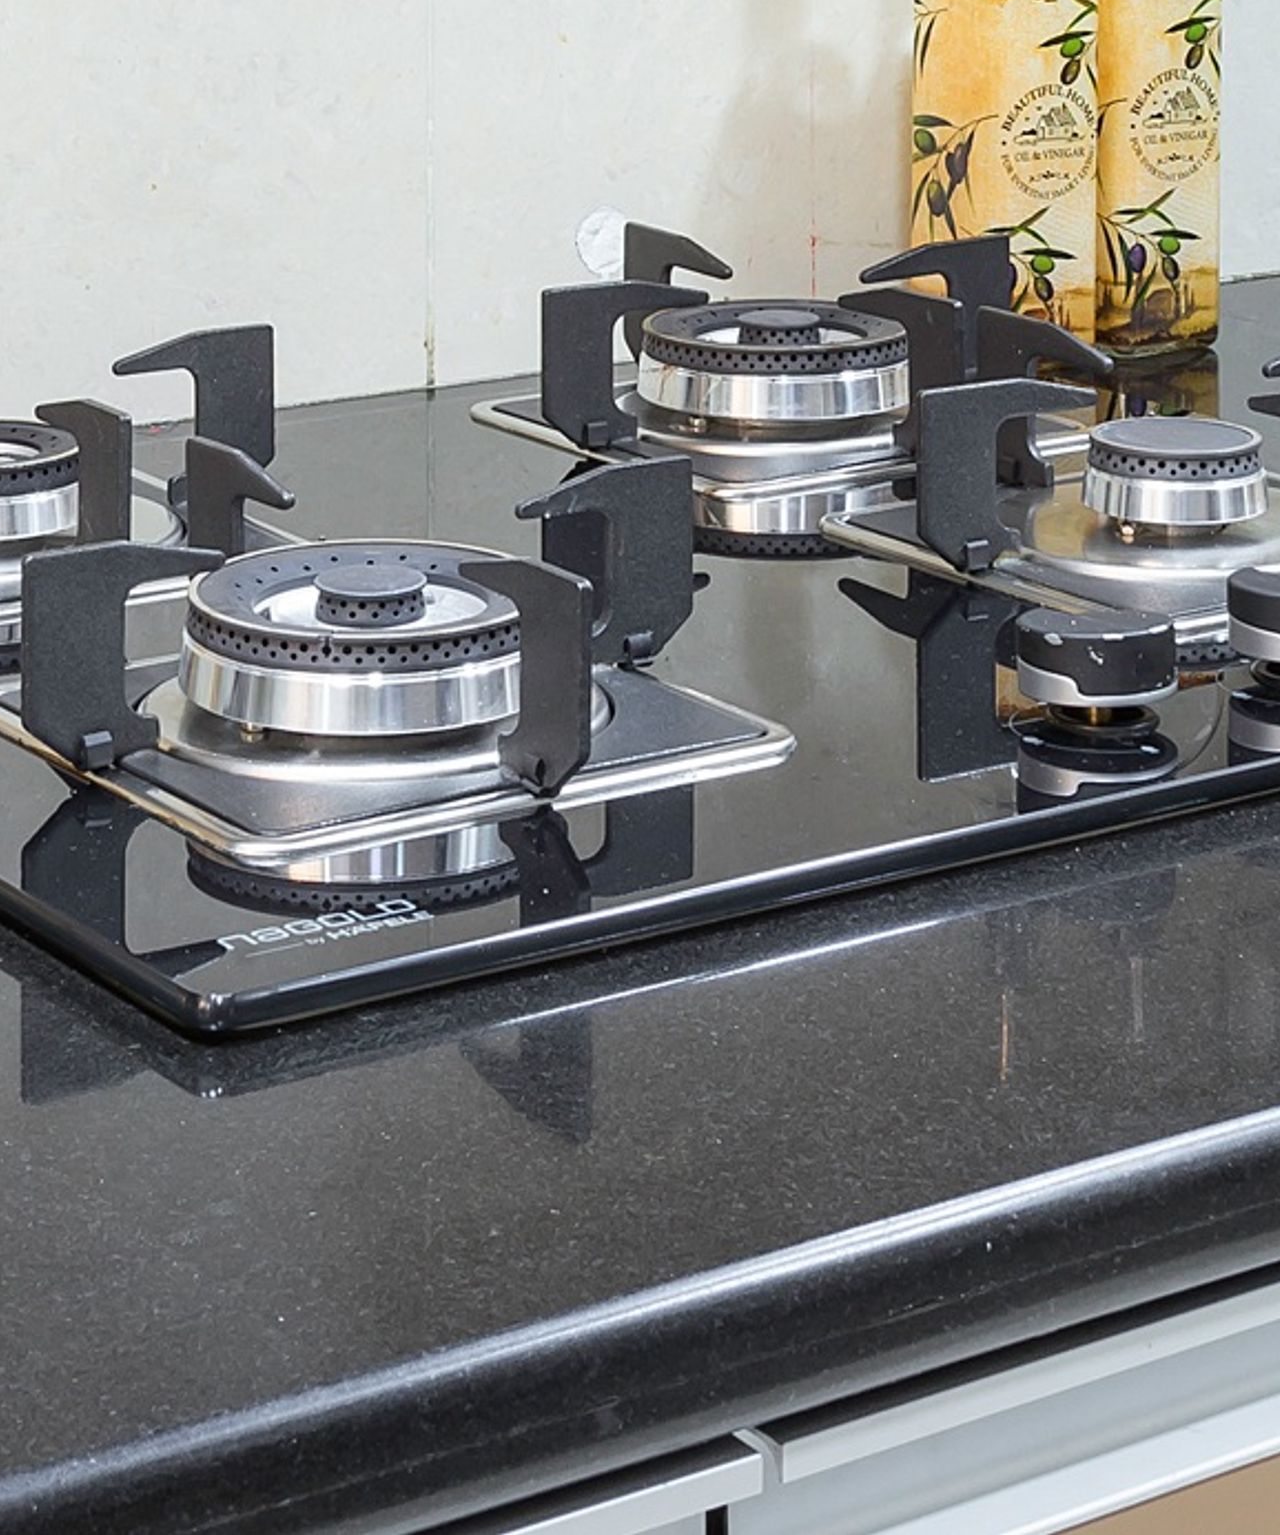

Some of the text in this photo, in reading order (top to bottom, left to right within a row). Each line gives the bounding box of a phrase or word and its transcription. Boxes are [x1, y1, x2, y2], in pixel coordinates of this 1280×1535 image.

[1001, 84, 1095, 132] BEAUTIFUL HOME
[1130, 68, 1188, 116] BEAUTIFUL
